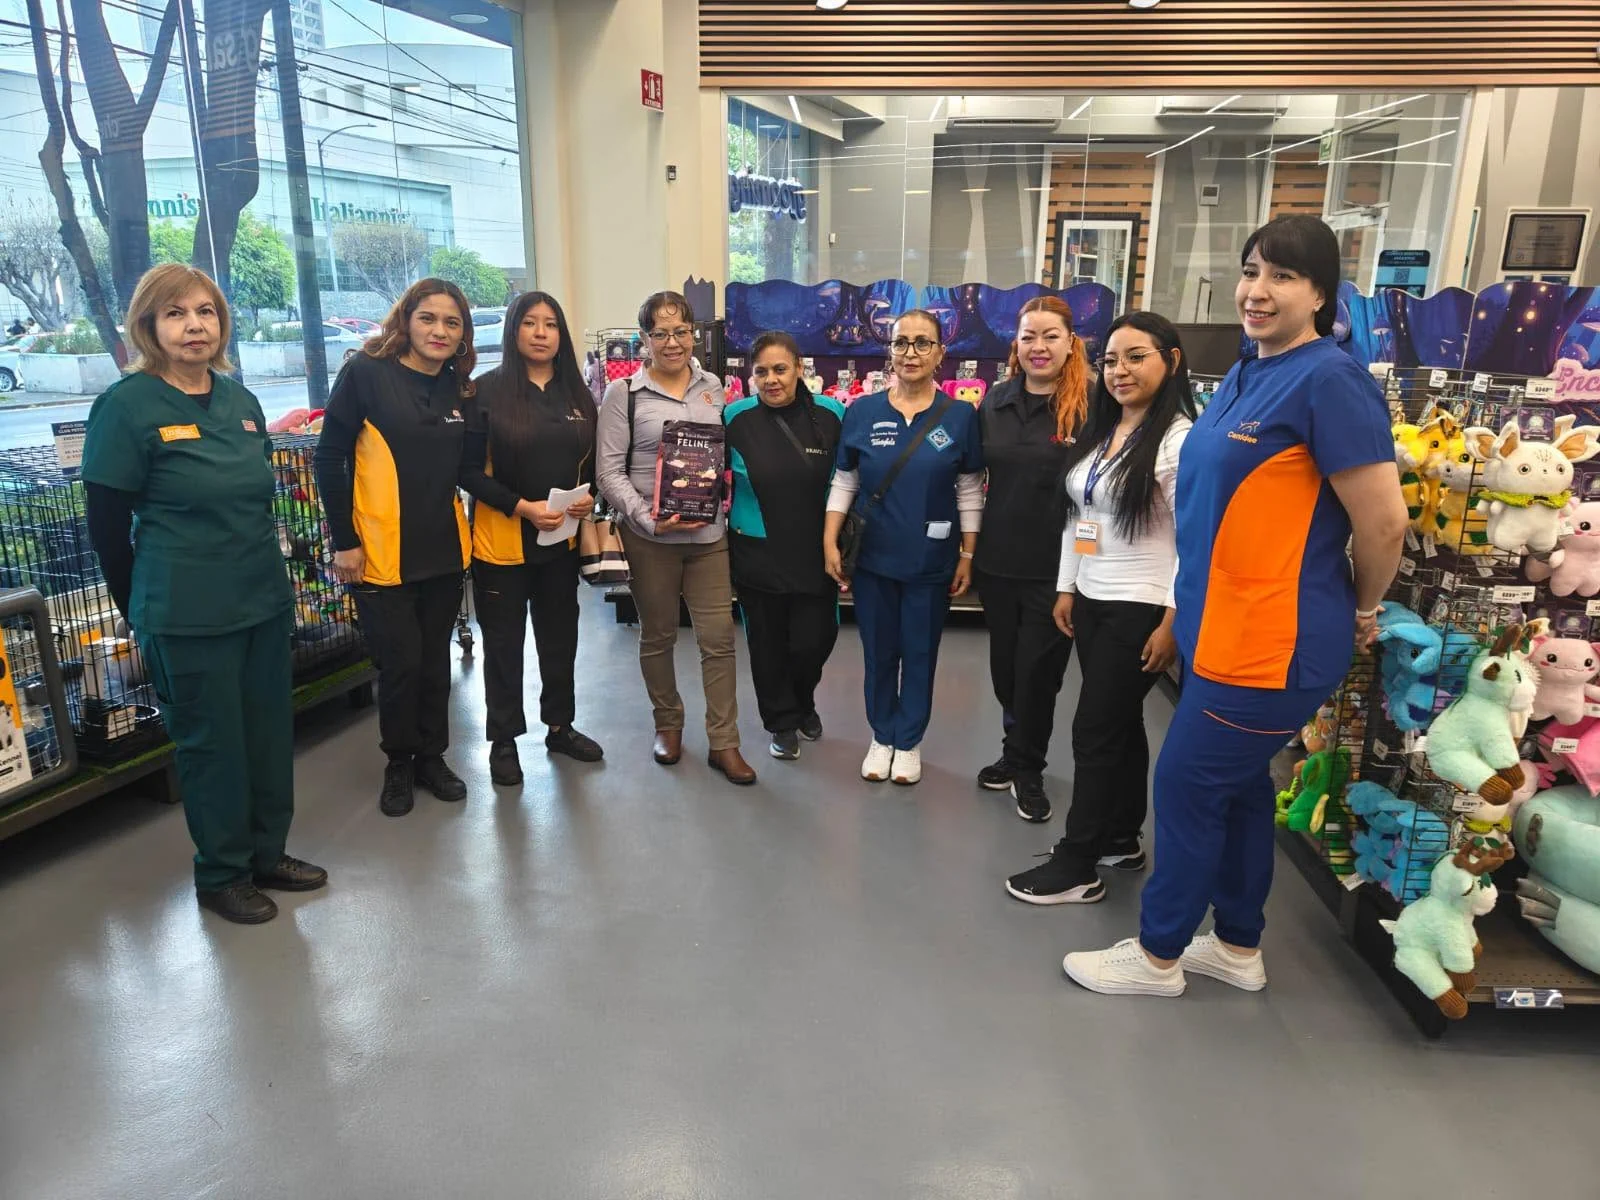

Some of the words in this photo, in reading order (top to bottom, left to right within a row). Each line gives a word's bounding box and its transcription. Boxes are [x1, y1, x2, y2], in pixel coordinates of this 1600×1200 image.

[1555, 366, 1600, 394] Enc
[677, 438, 709, 449] FELINE
[0, 751, 22, 767] ennel
